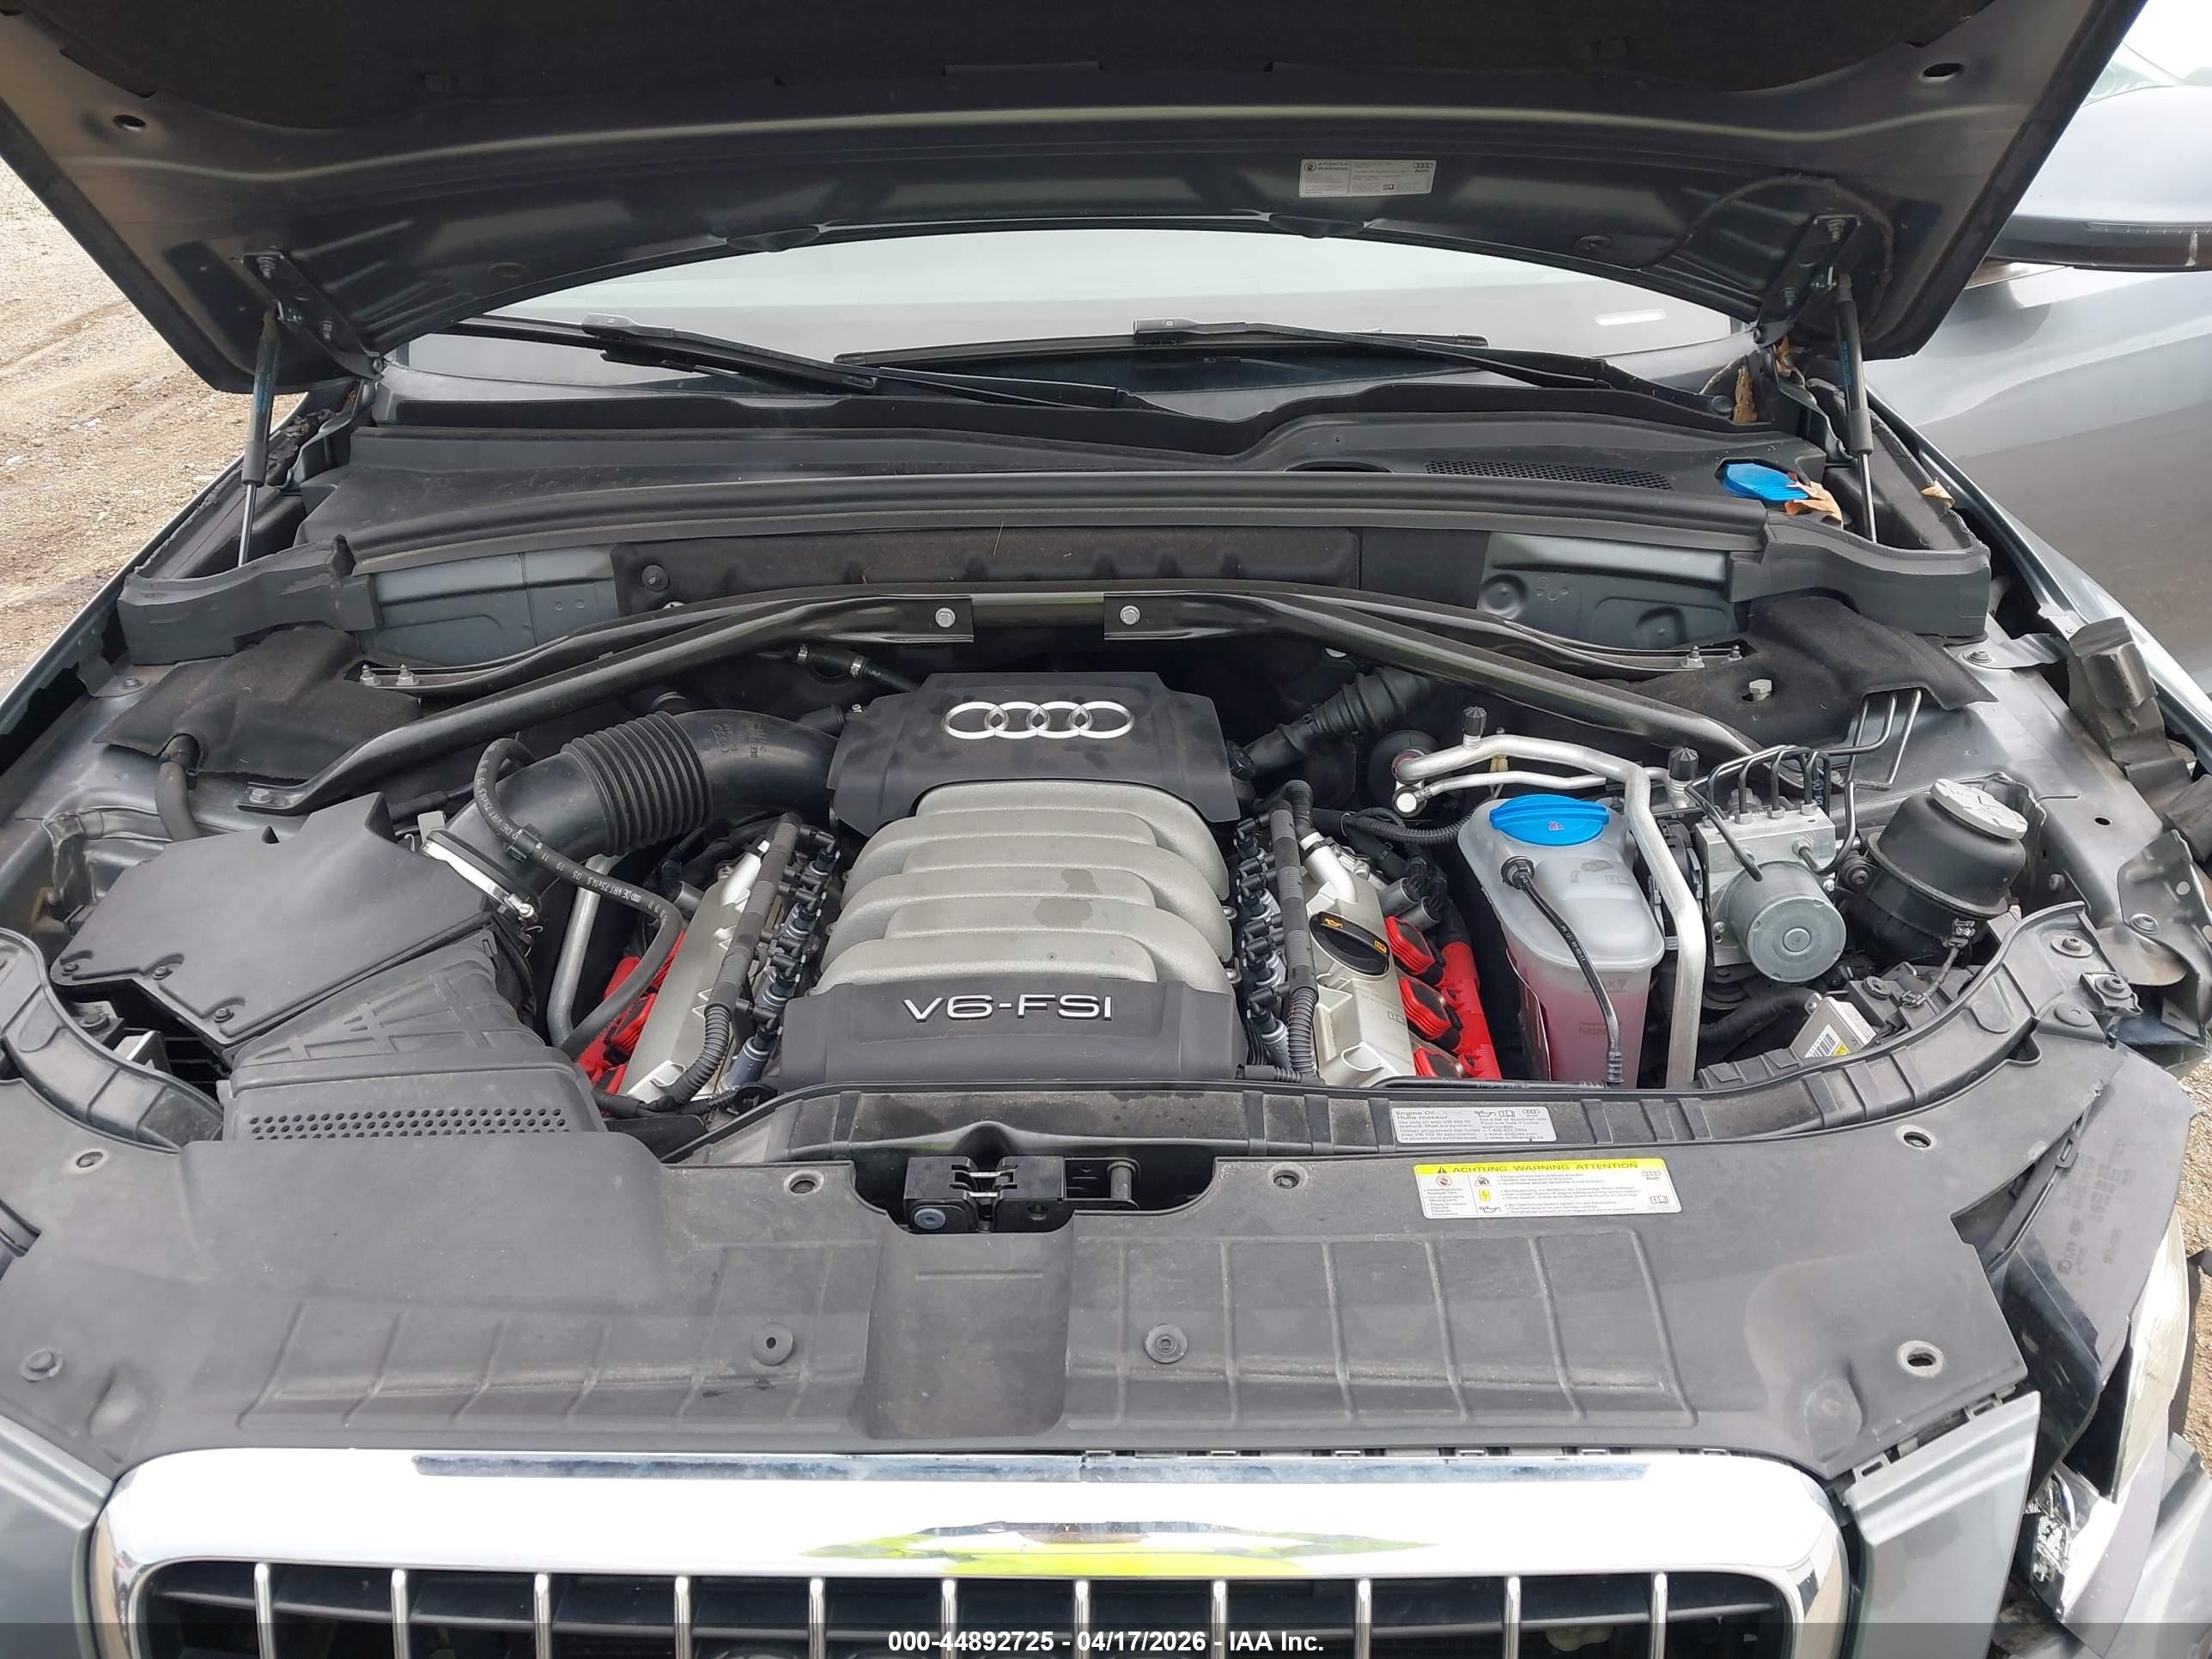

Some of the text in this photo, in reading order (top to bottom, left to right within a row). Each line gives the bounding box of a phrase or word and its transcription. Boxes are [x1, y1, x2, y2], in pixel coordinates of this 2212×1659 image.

[488, 811, 503, 824] VRT
[501, 823, 514, 836] DE
[556, 861, 564, 872] 19
[571, 870, 583, 880] 05
[609, 884, 622, 897] VRT
[620, 888, 633, 900] DE
[902, 994, 1113, 1023] V6-FSI
